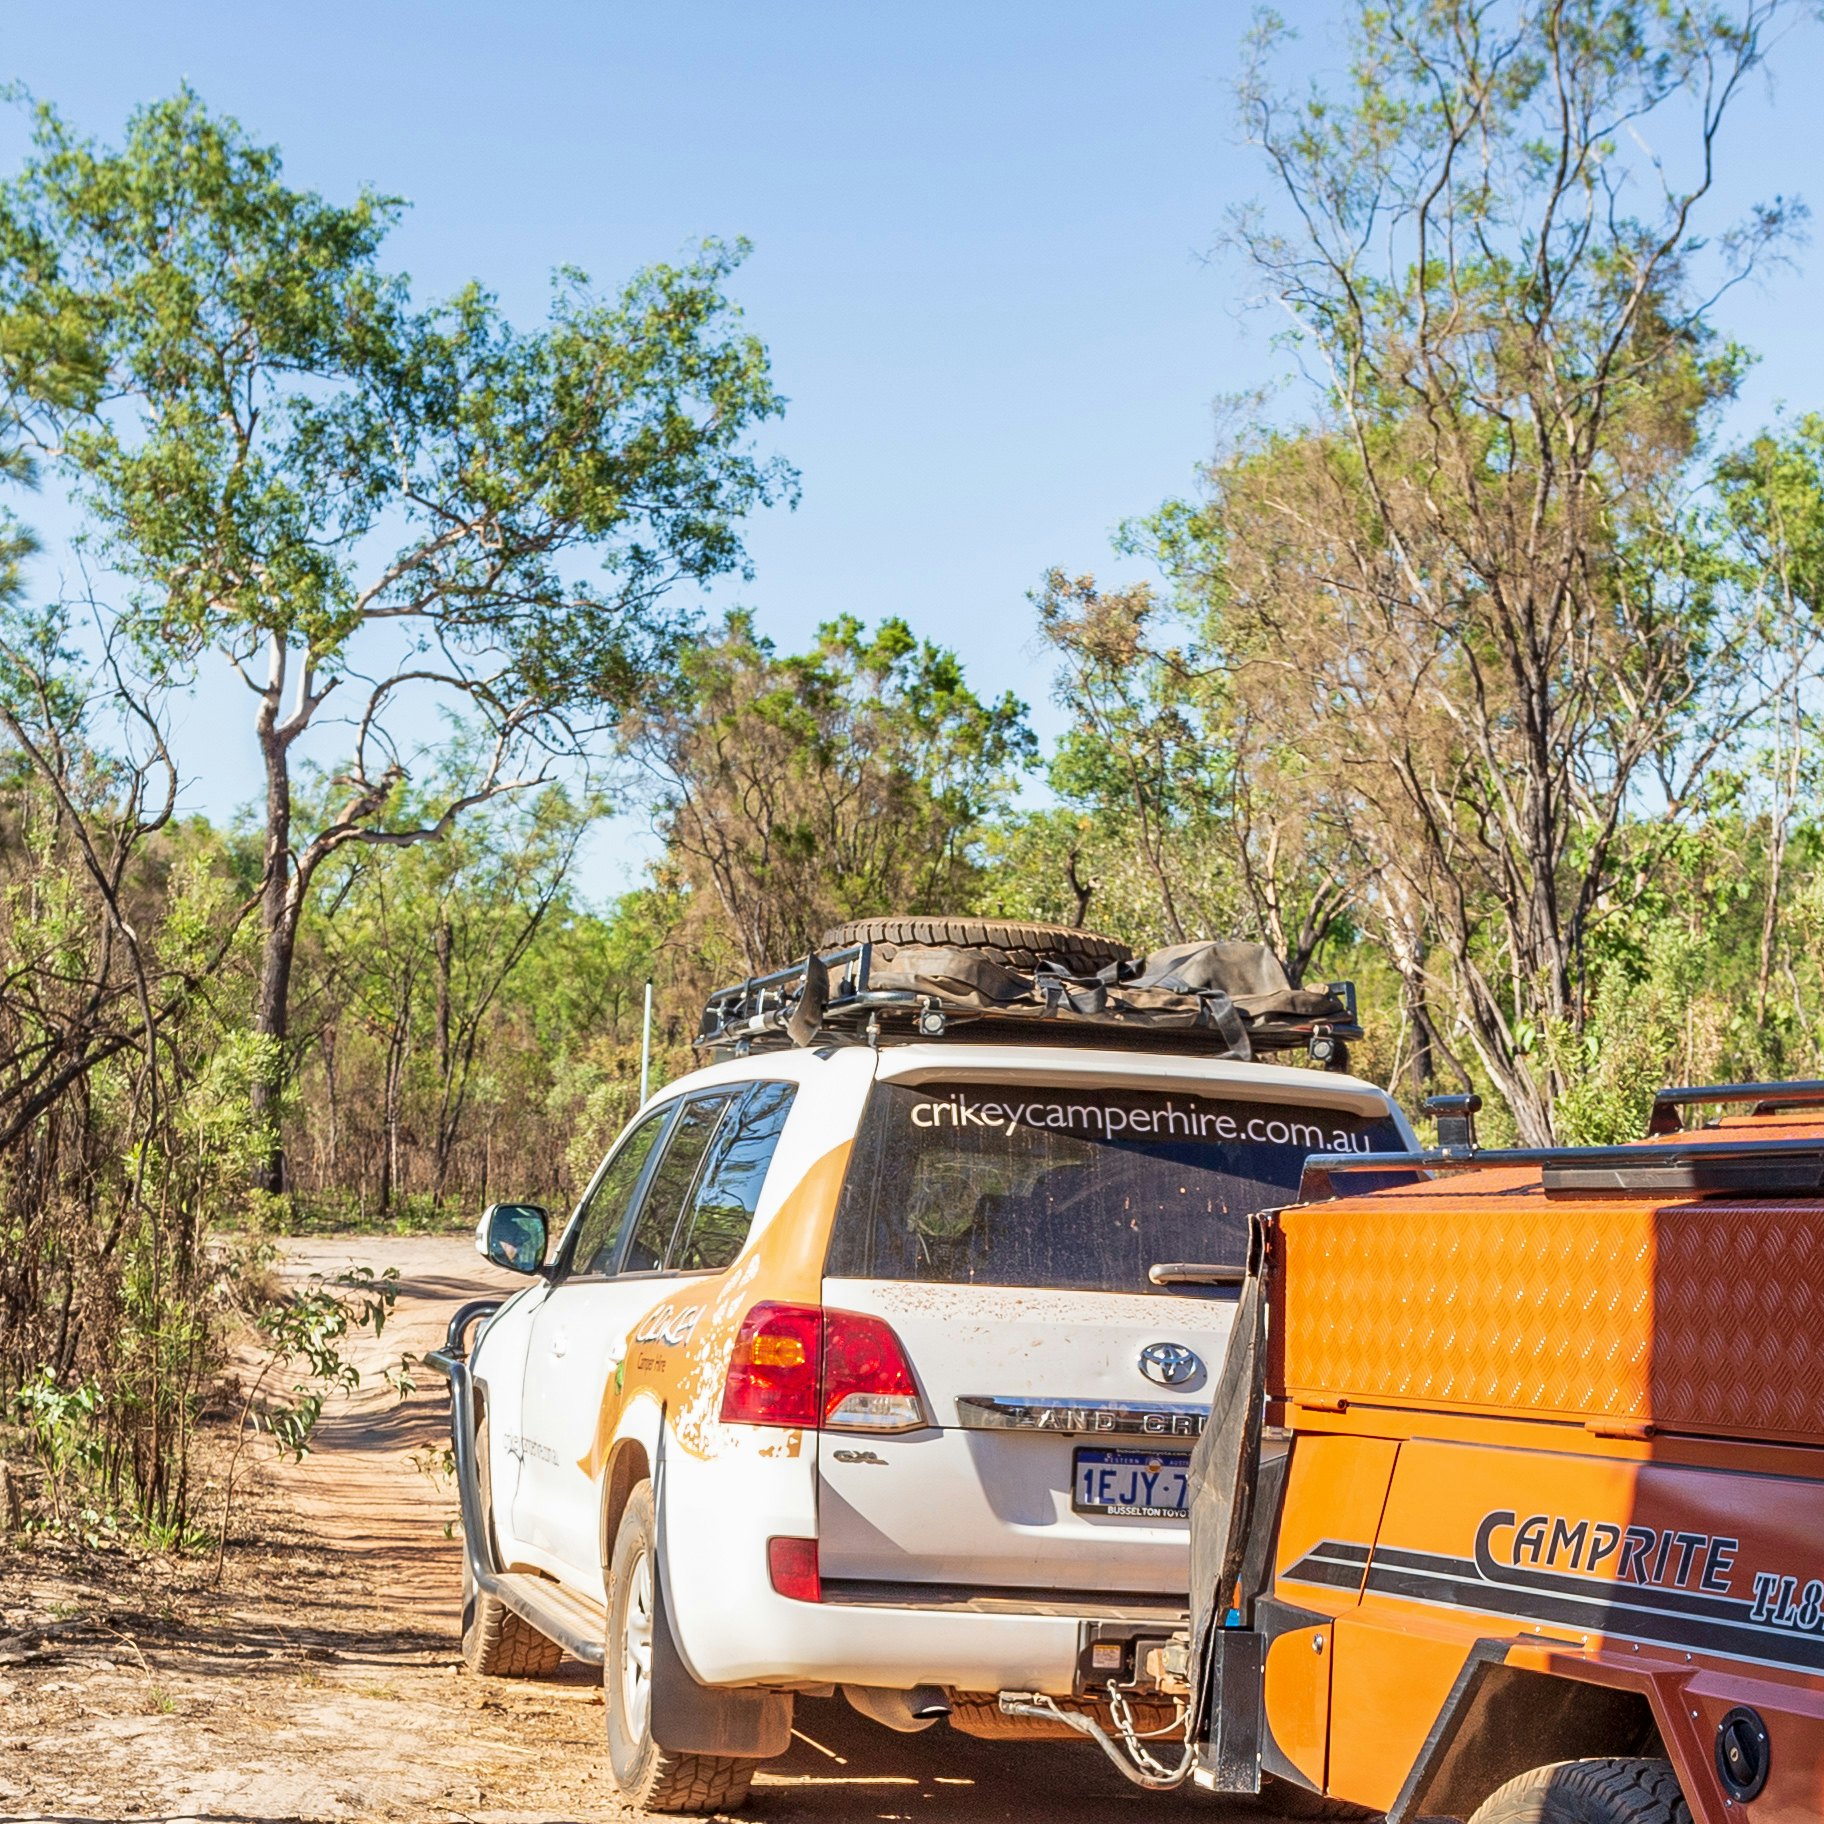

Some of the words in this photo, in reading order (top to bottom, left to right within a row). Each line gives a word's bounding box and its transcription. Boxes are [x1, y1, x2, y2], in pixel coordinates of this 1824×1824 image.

[910, 1094, 1370, 1153] crikeycamperhire.com.au
[1016, 1408, 1116, 1431] LAND
[1107, 1506, 1160, 1517] BUSSELTON
[1162, 1509, 1190, 1518] TOYO
[1474, 1510, 1739, 1592] CAMPRITE
